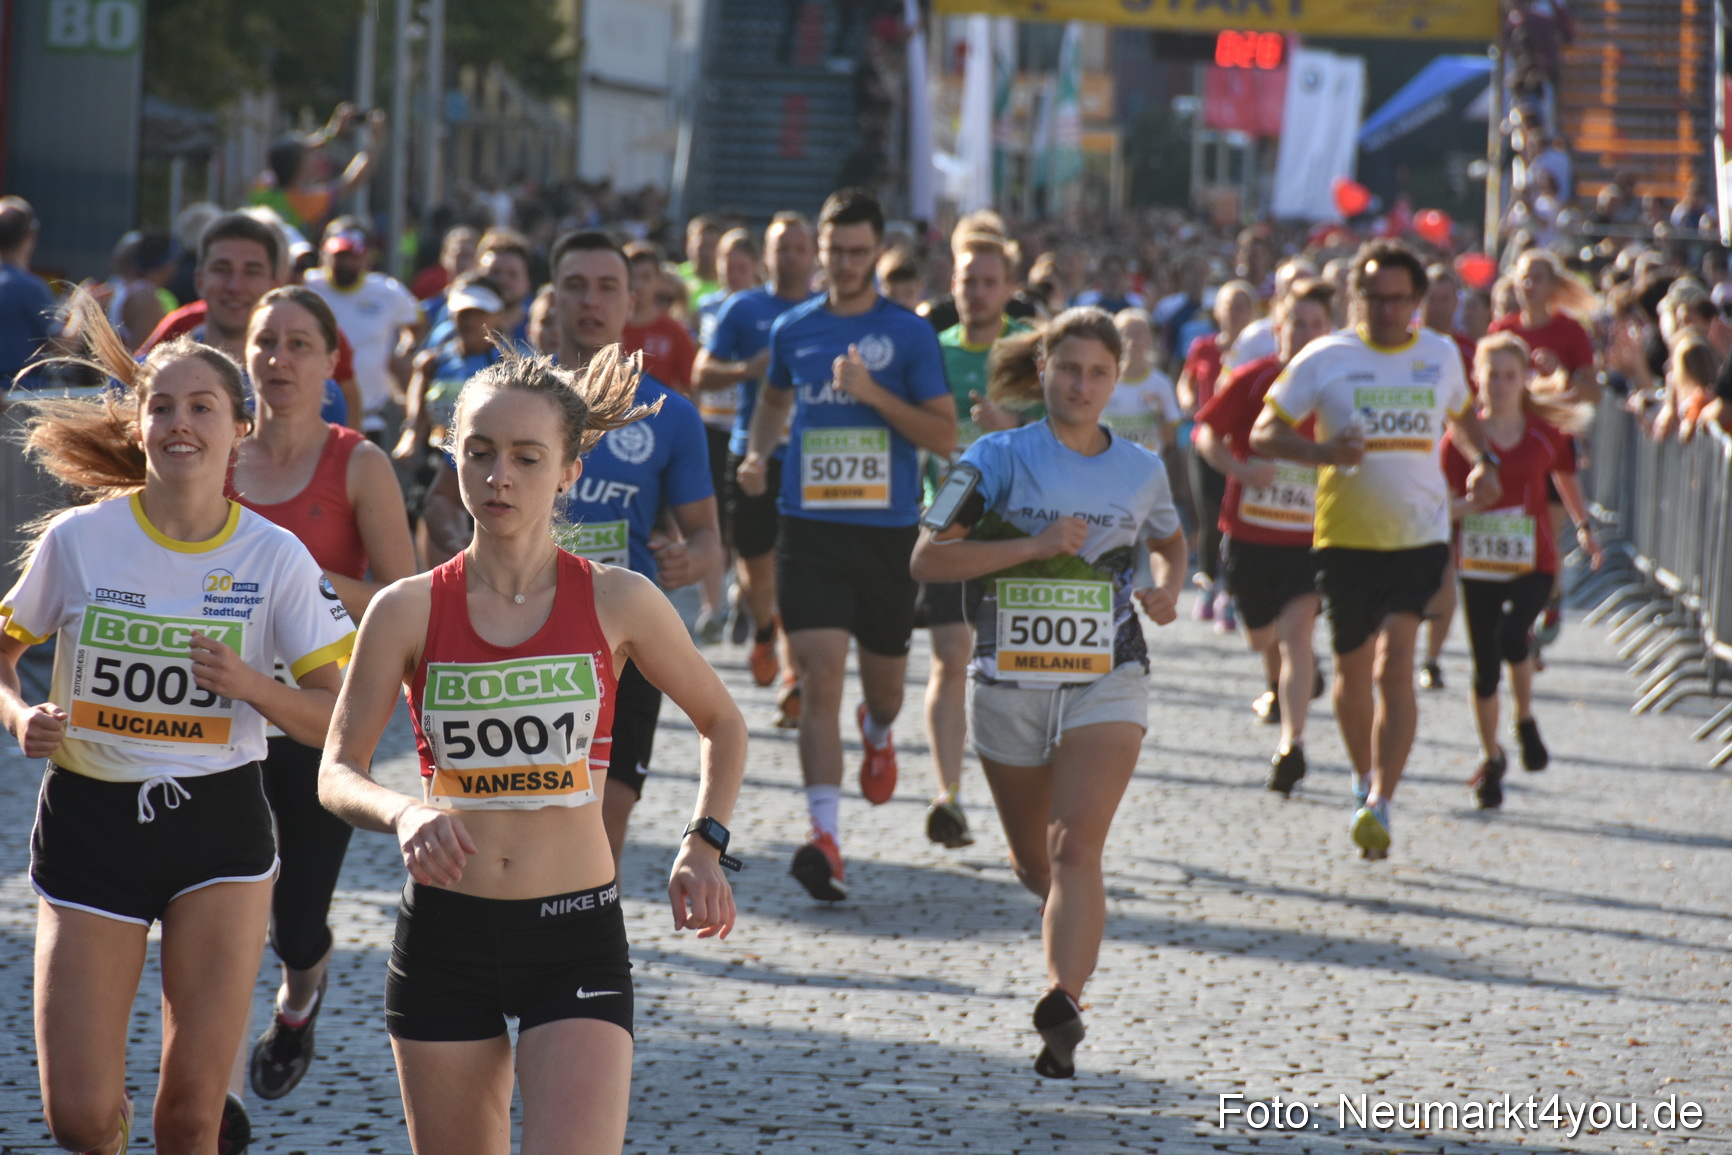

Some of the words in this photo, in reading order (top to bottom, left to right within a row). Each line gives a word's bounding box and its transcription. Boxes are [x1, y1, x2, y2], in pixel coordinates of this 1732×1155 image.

[1365, 411, 1428, 433] 5060
[811, 456, 877, 480] 5078
[206, 575, 232, 592] 20
[234, 583, 257, 591] JAHRE
[96, 588, 146, 605] BOCK
[204, 594, 264, 605] Neumarkter
[1006, 584, 1102, 609] BOCK
[202, 607, 252, 619] Stadtlauf
[1010, 616, 1098, 646] 5002
[1014, 655, 1092, 670] MELANIE
[434, 662, 584, 705] BOCK
[97, 710, 204, 739] LUCIANA
[442, 712, 575, 759] 5001
[457, 770, 574, 794] VANESSA
[540, 894, 595, 917] NIKE
